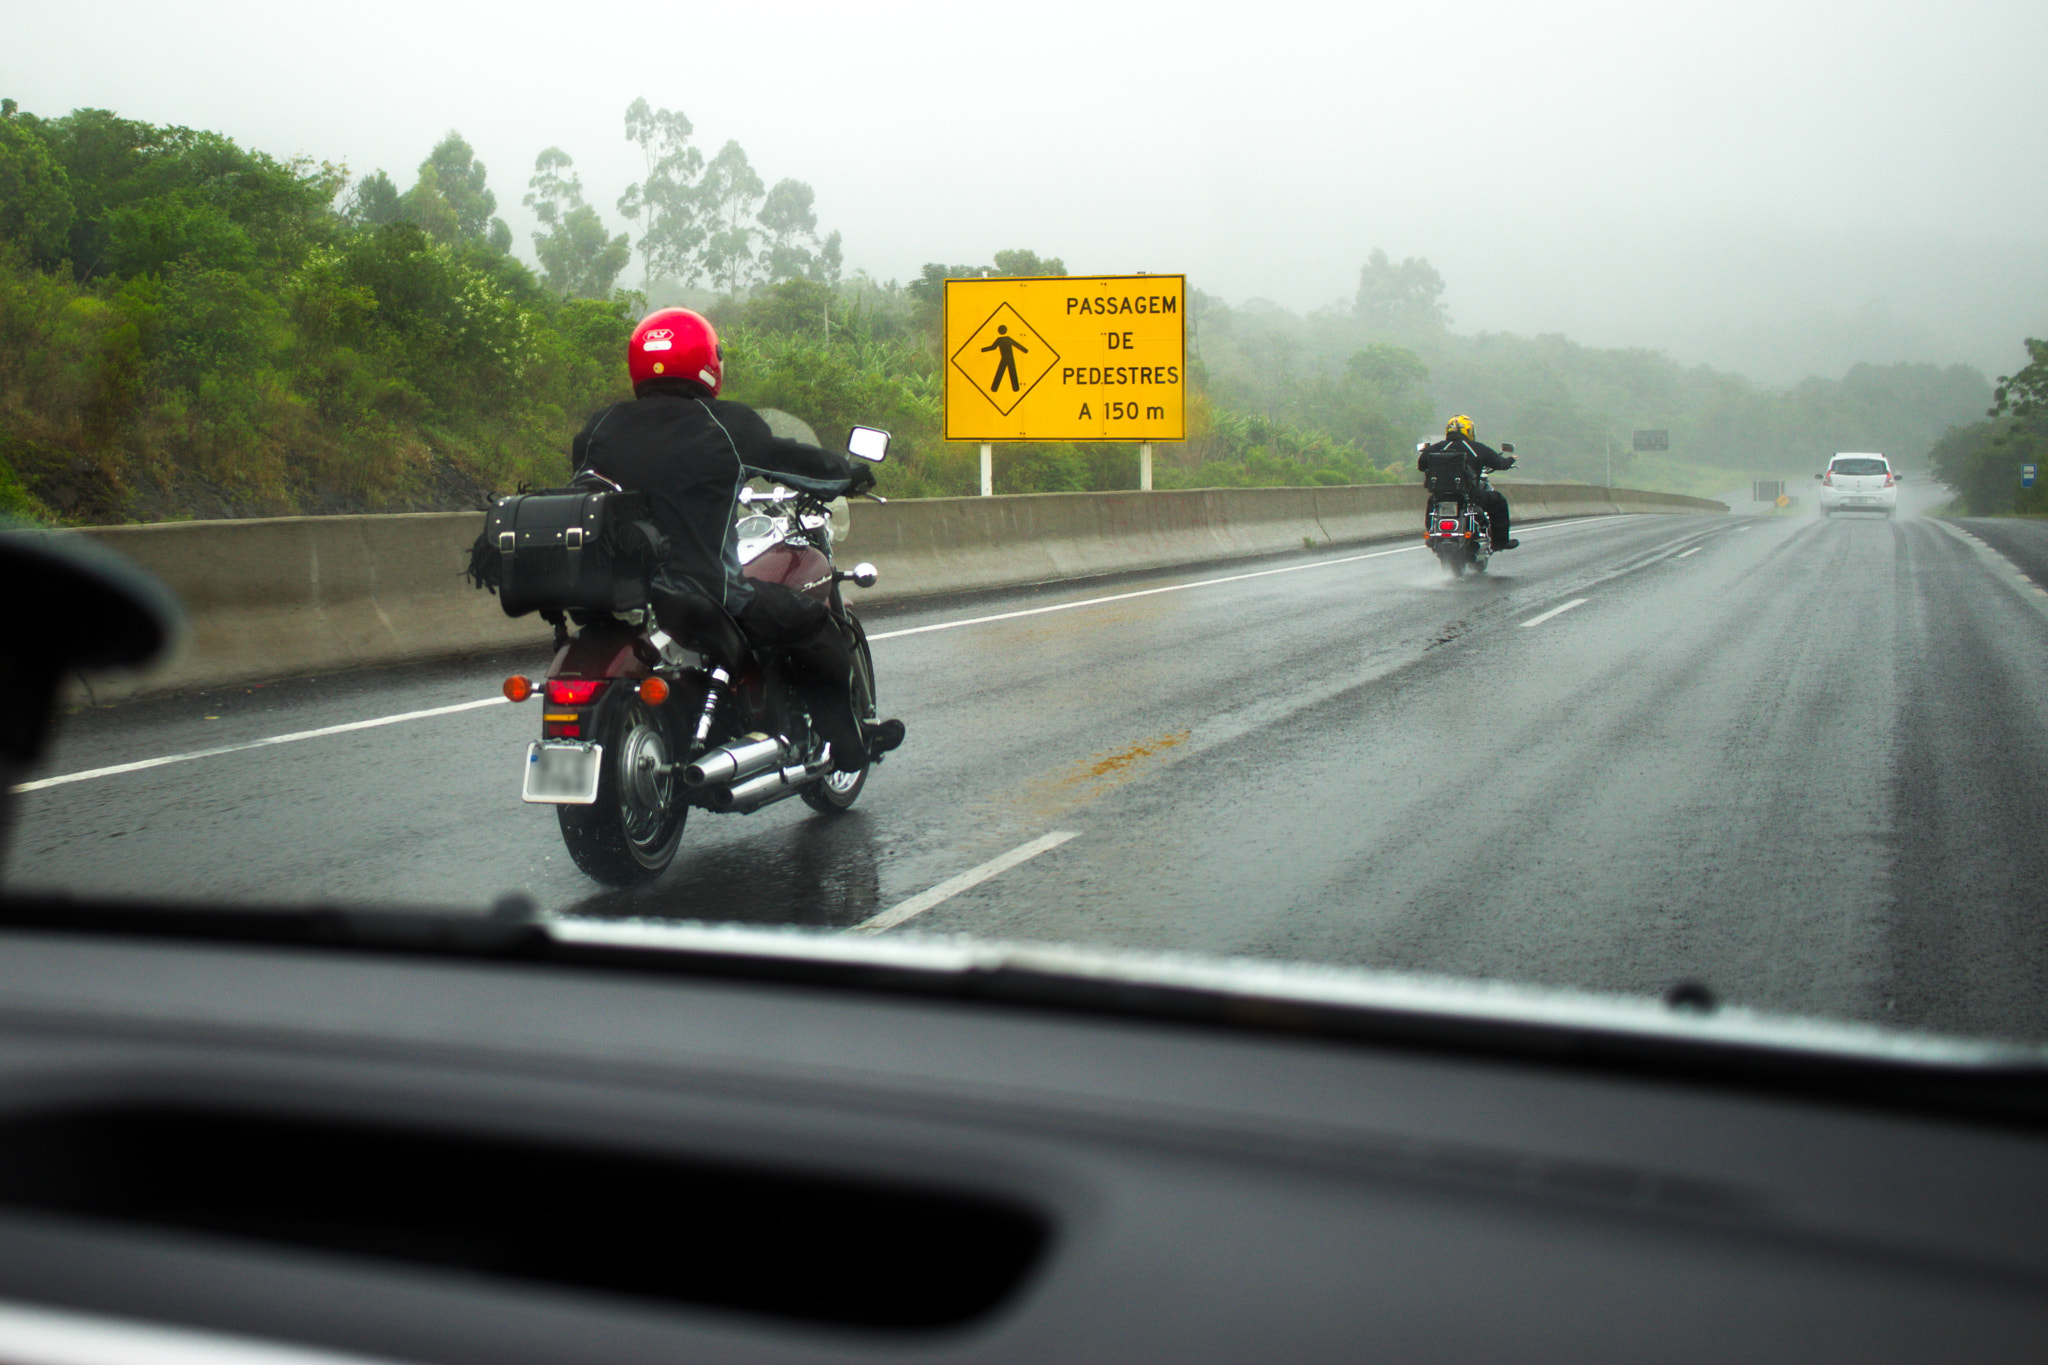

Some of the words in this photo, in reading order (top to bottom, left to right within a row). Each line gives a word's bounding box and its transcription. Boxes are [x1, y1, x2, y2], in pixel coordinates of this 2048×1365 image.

[1066, 296, 1177, 315] PASSAGEM
[646, 331, 669, 340] FLY
[1108, 332, 1134, 350] DE
[1063, 366, 1179, 385] PEDESTRES
[1078, 402, 1092, 420] A
[1104, 402, 1139, 420] 150
[1146, 406, 1165, 420] m
